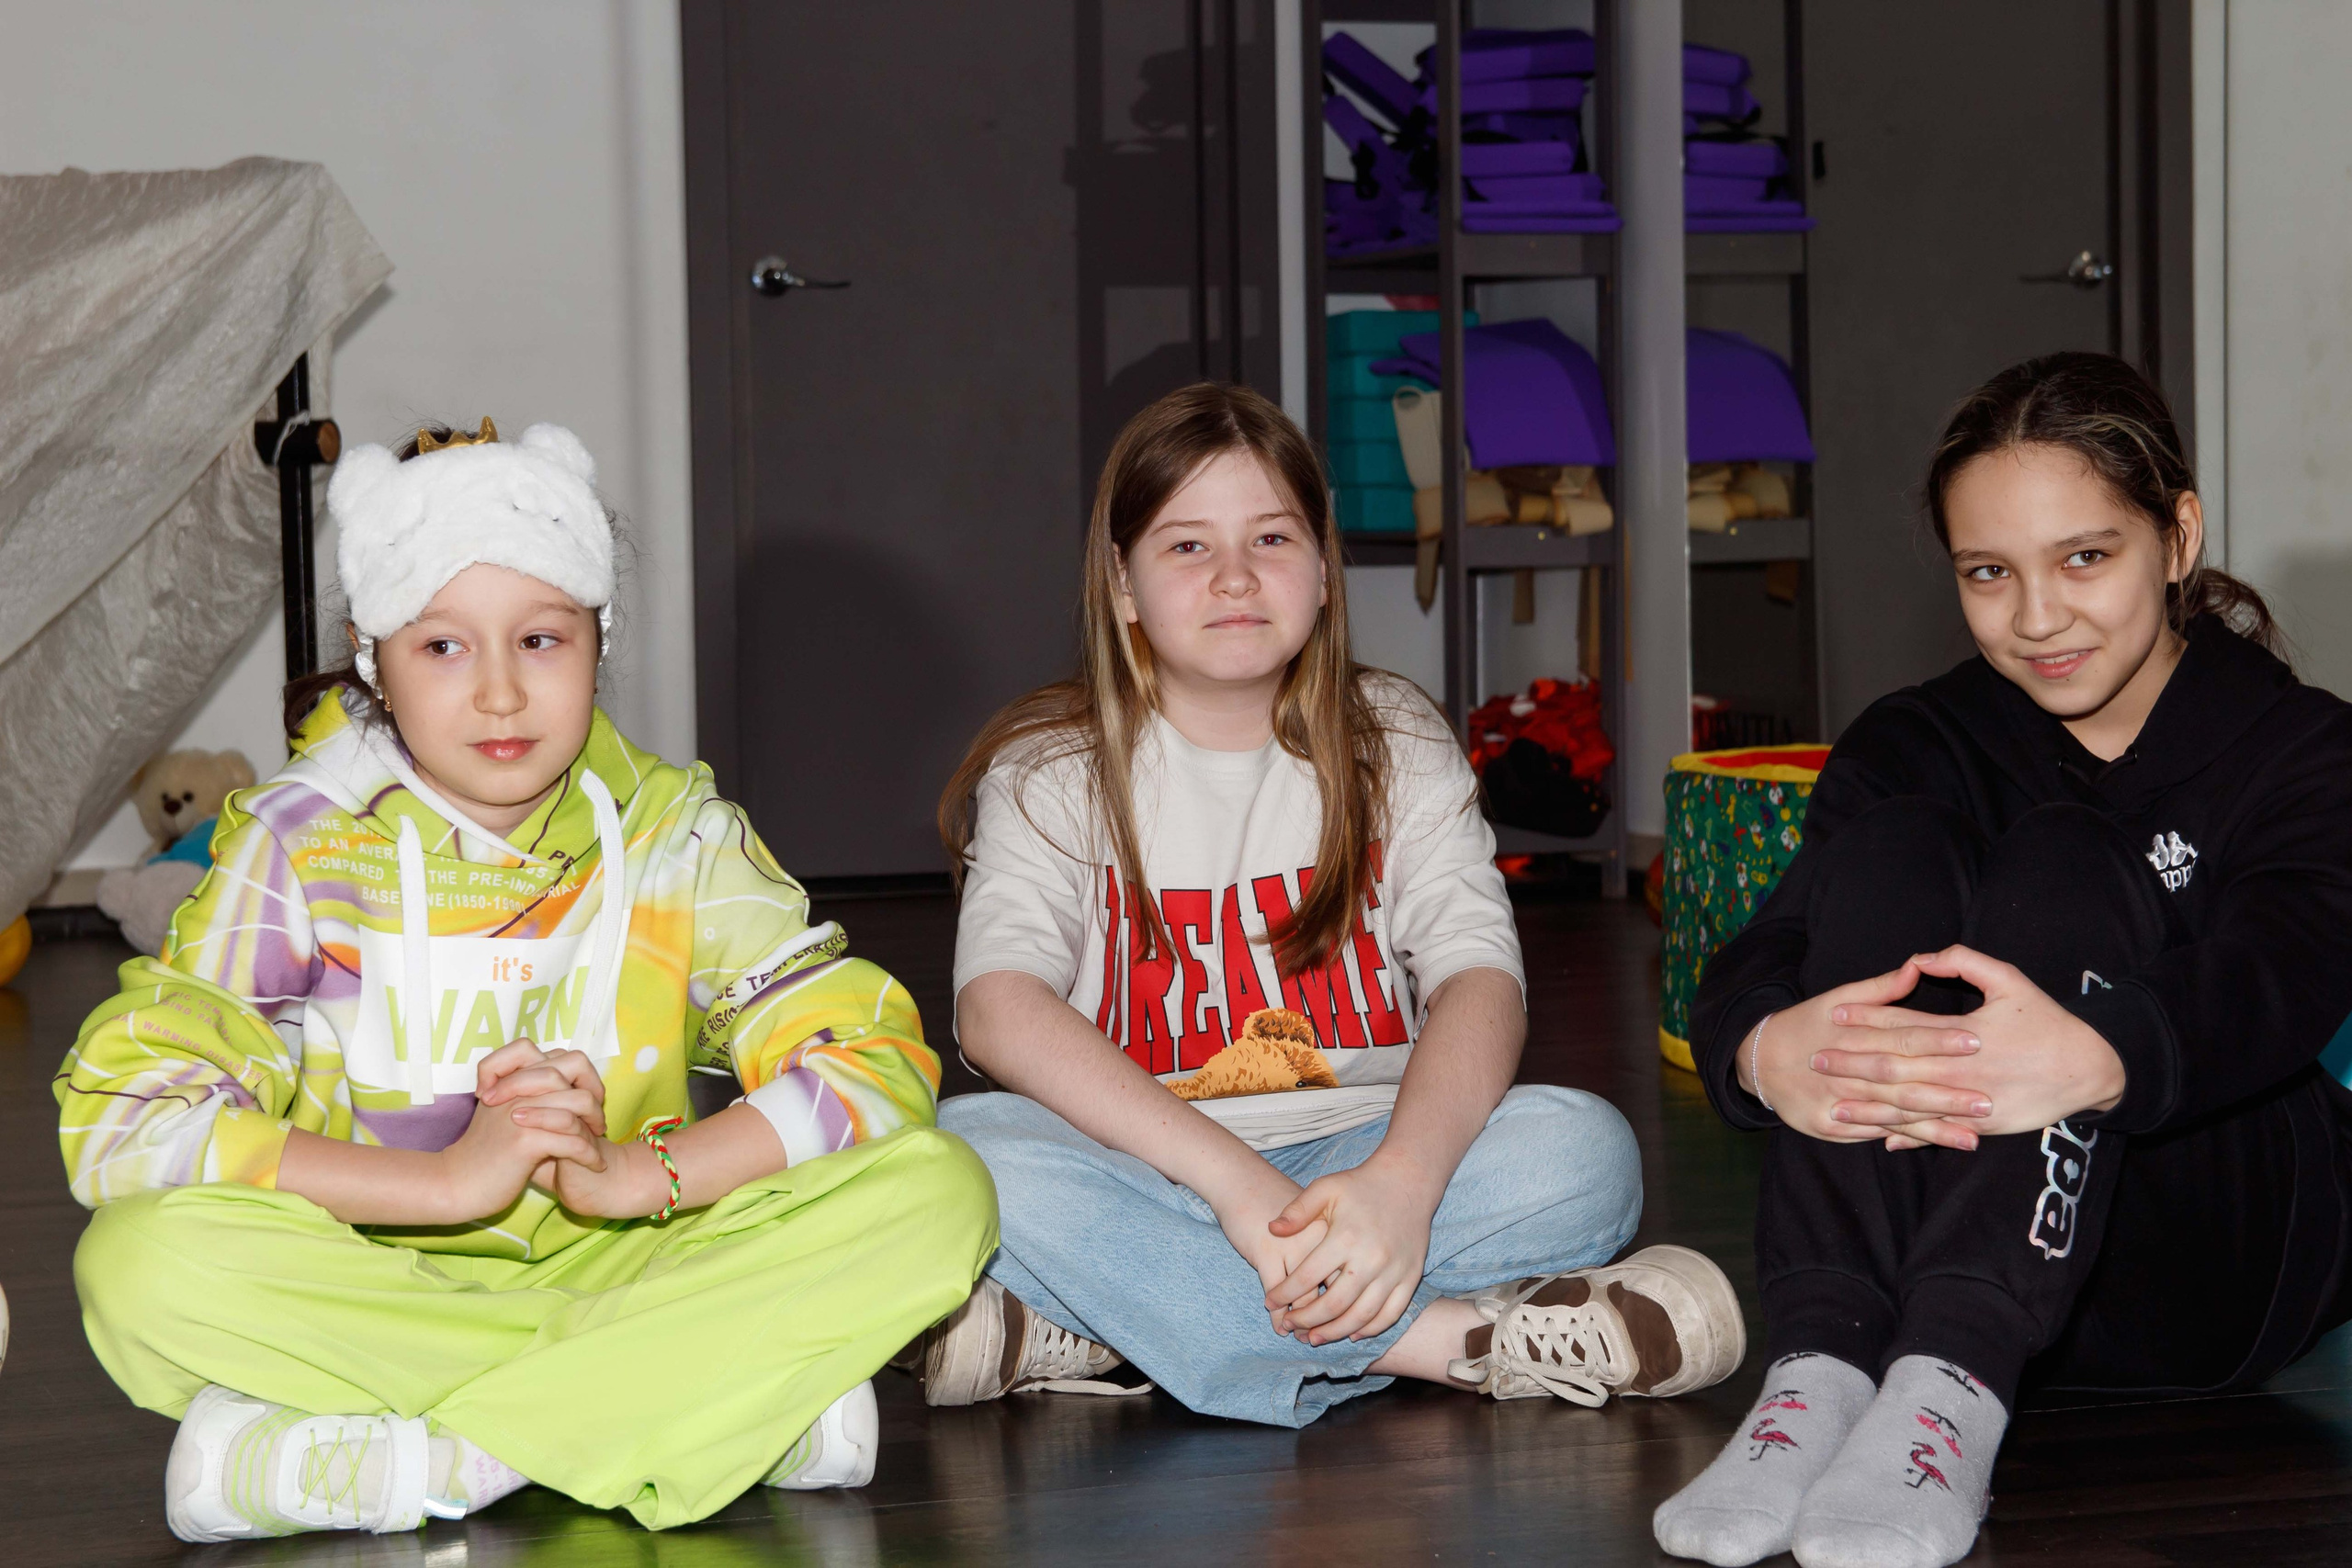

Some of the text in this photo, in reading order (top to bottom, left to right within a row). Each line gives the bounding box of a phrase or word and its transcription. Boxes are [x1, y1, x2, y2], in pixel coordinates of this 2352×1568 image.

[309, 819, 343, 831] THE
[300, 837, 322, 849] TO
[329, 838, 349, 852] AN
[308, 855, 384, 881] COMPARED
[428, 870, 458, 885] THE
[492, 956, 534, 982] it's
